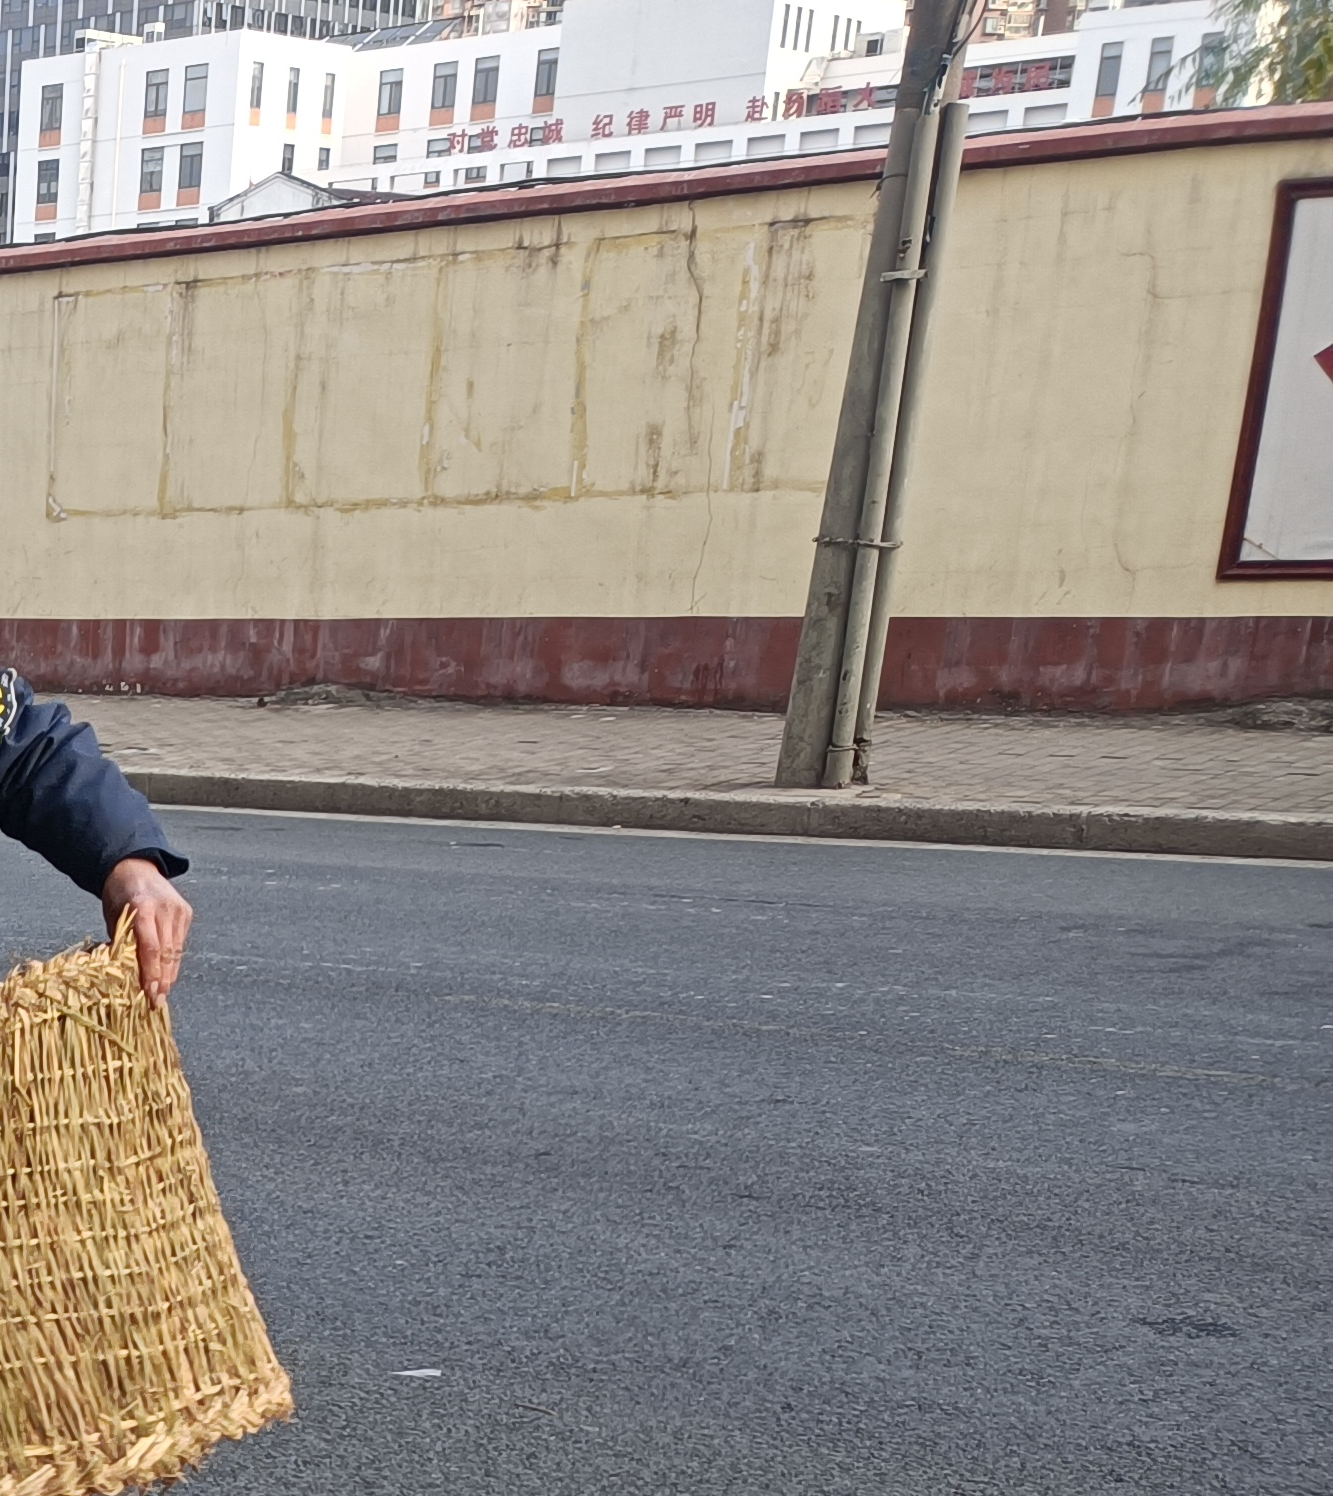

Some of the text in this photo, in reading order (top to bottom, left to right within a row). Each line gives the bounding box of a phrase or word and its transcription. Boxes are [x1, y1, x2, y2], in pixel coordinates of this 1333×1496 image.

[447, 118, 564, 154] 对党忠诚
[591, 102, 717, 138] 纪律严明
